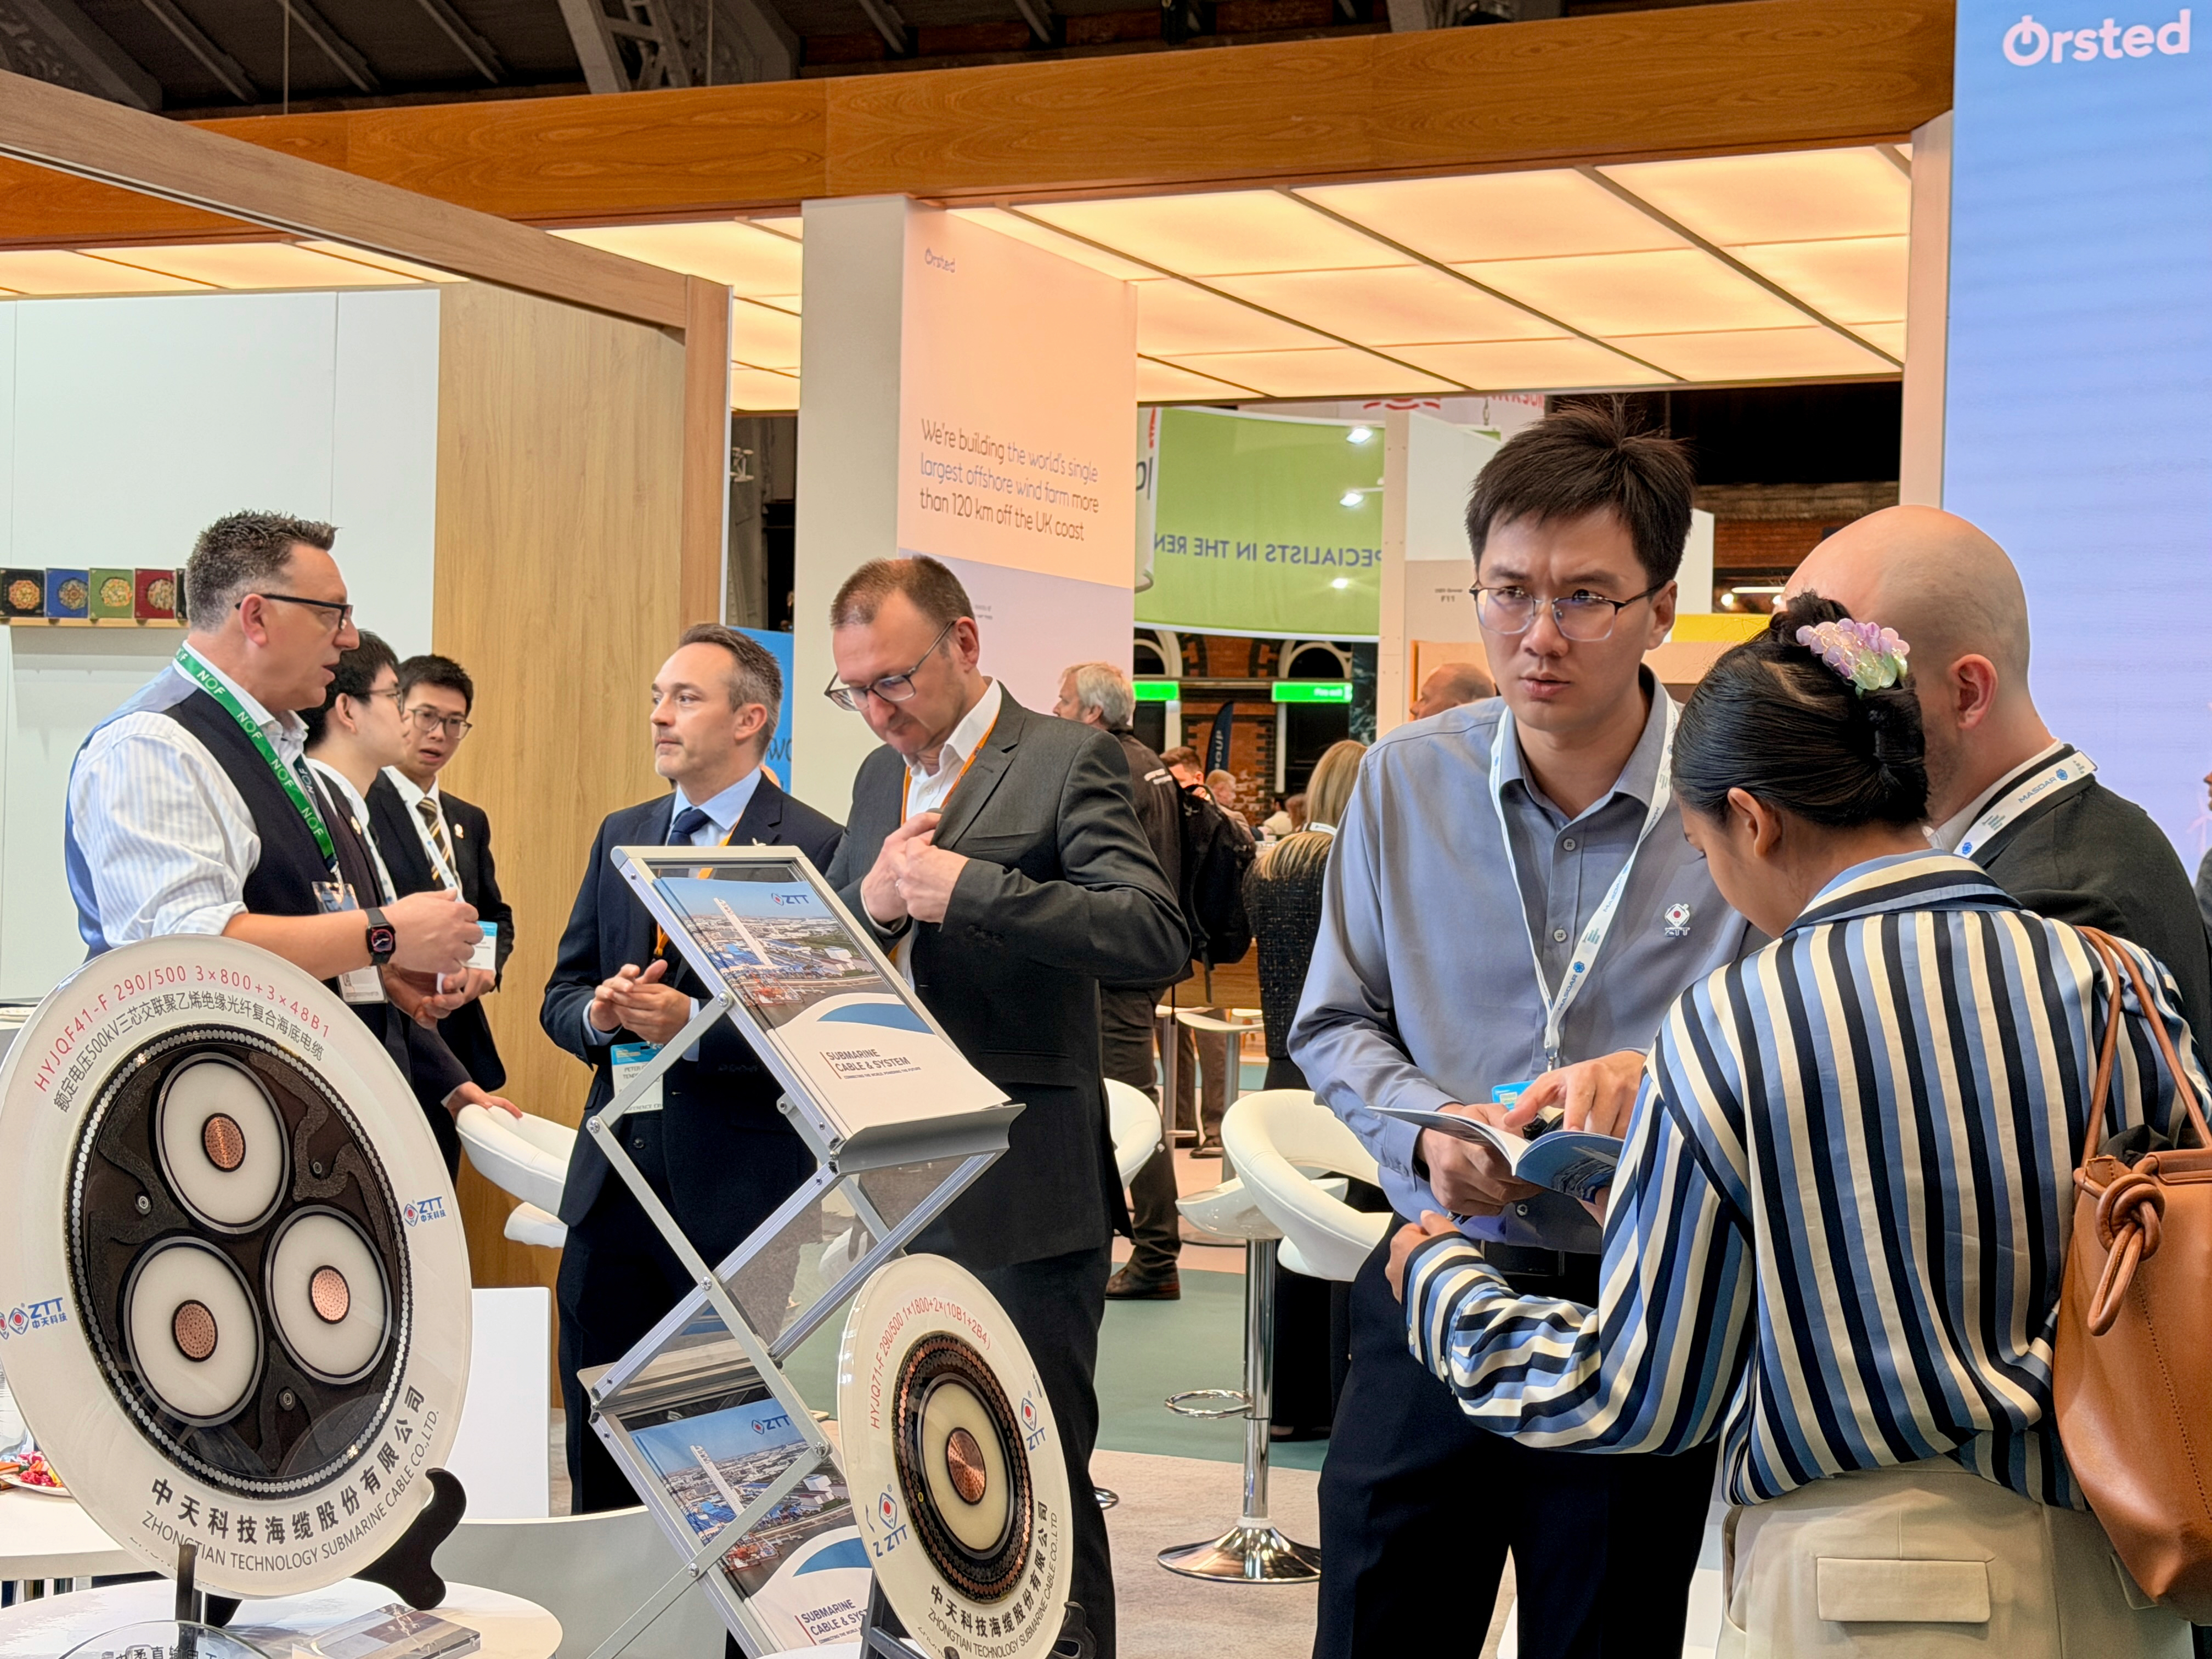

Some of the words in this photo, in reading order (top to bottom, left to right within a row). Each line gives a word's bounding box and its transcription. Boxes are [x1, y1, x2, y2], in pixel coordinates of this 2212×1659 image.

[921, 418, 956, 448] We're
[959, 427, 1005, 465] building
[1007, 442, 1025, 465] the
[1029, 451, 1065, 475] world's
[1068, 458, 1098, 485] single
[921, 452, 963, 484] largest
[966, 465, 1013, 494] offshore
[1016, 477, 1042, 500] wind
[1045, 482, 1069, 507] farm
[1072, 493, 1099, 513] more
[920, 487, 949, 514] than
[952, 493, 972, 517] 120
[975, 498, 993, 522] km
[996, 504, 1013, 526] off
[1015, 508, 1032, 530] the
[1036, 511, 1052, 534] UK
[1055, 521, 1084, 541] coast
[197, 670, 225, 695] NOF
[236, 712, 262, 740] NOF
[272, 759, 295, 788] NOF
[2018, 776, 2057, 803] MASDAR
[302, 807, 324, 837] NOF
[781, 895, 809, 904] ZTT
[1664, 927, 1690, 936] ZTT
[1558, 974, 1577, 1011] MASDAR
[35, 994, 108, 1092] HYJQF41-F
[114, 966, 186, 1001] 290/500
[826, 1049, 881, 1060] SUBMARINE
[835, 1062, 866, 1071] CABLE
[872, 1057, 911, 1068] SYSTEM
[417, 1196, 442, 1214] ZTT
[421, 1209, 446, 1222] 中天科技
[28, 1297, 63, 1319] ZTT
[32, 1312, 67, 1329] 中天科技
[871, 1352, 884, 1429] HYJQ71-F
[879, 1312, 903, 1357] 290/500
[762, 1415, 790, 1430] ZTT
[1026, 1427, 1046, 1451] ZTT
[151, 1385, 425, 1545] 中天科技海缆股份有限公司
[230, 1547, 318, 1572] TECHNOLOGY
[321, 1503, 387, 1559] SUBMARINE
[386, 1465, 414, 1507] CABLE
[884, 1524, 907, 1551] ZTT
[931, 1500, 1047, 1638] 中天科技海缆股份有限公司
[801, 1599, 856, 1623] SUBMARINE
[928, 1607, 972, 1653] ZHONGTIAN
[973, 1640, 1020, 1658] TECHNOLOGY
[1019, 1597, 1048, 1646] SUBMARINE
[1044, 1562, 1056, 1599] CABLE
[810, 1619, 841, 1635] CABLE
[840, 1617, 849, 1626] &
